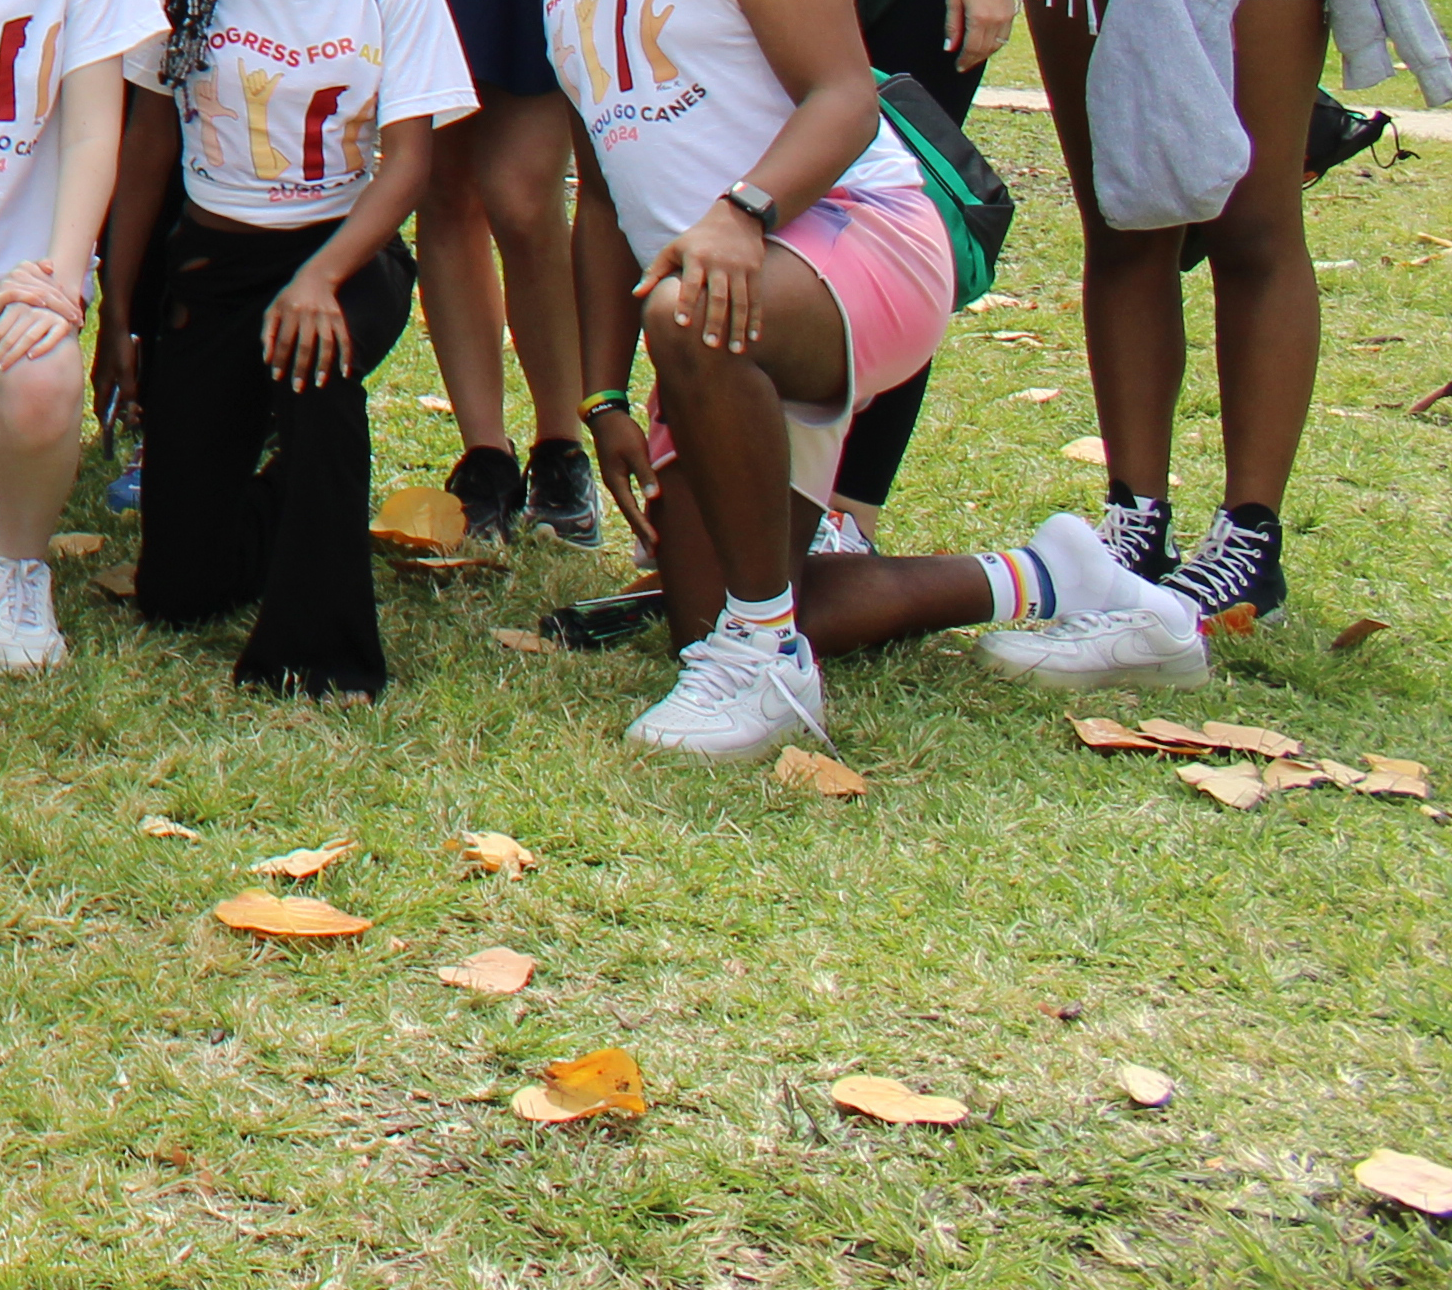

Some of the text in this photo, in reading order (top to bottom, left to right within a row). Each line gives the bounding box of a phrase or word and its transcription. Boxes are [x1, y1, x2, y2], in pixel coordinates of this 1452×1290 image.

[308, 37, 355, 65] FOR
[589, 83, 707, 140] YOU GO CANES
[603, 124, 639, 151] 2024
